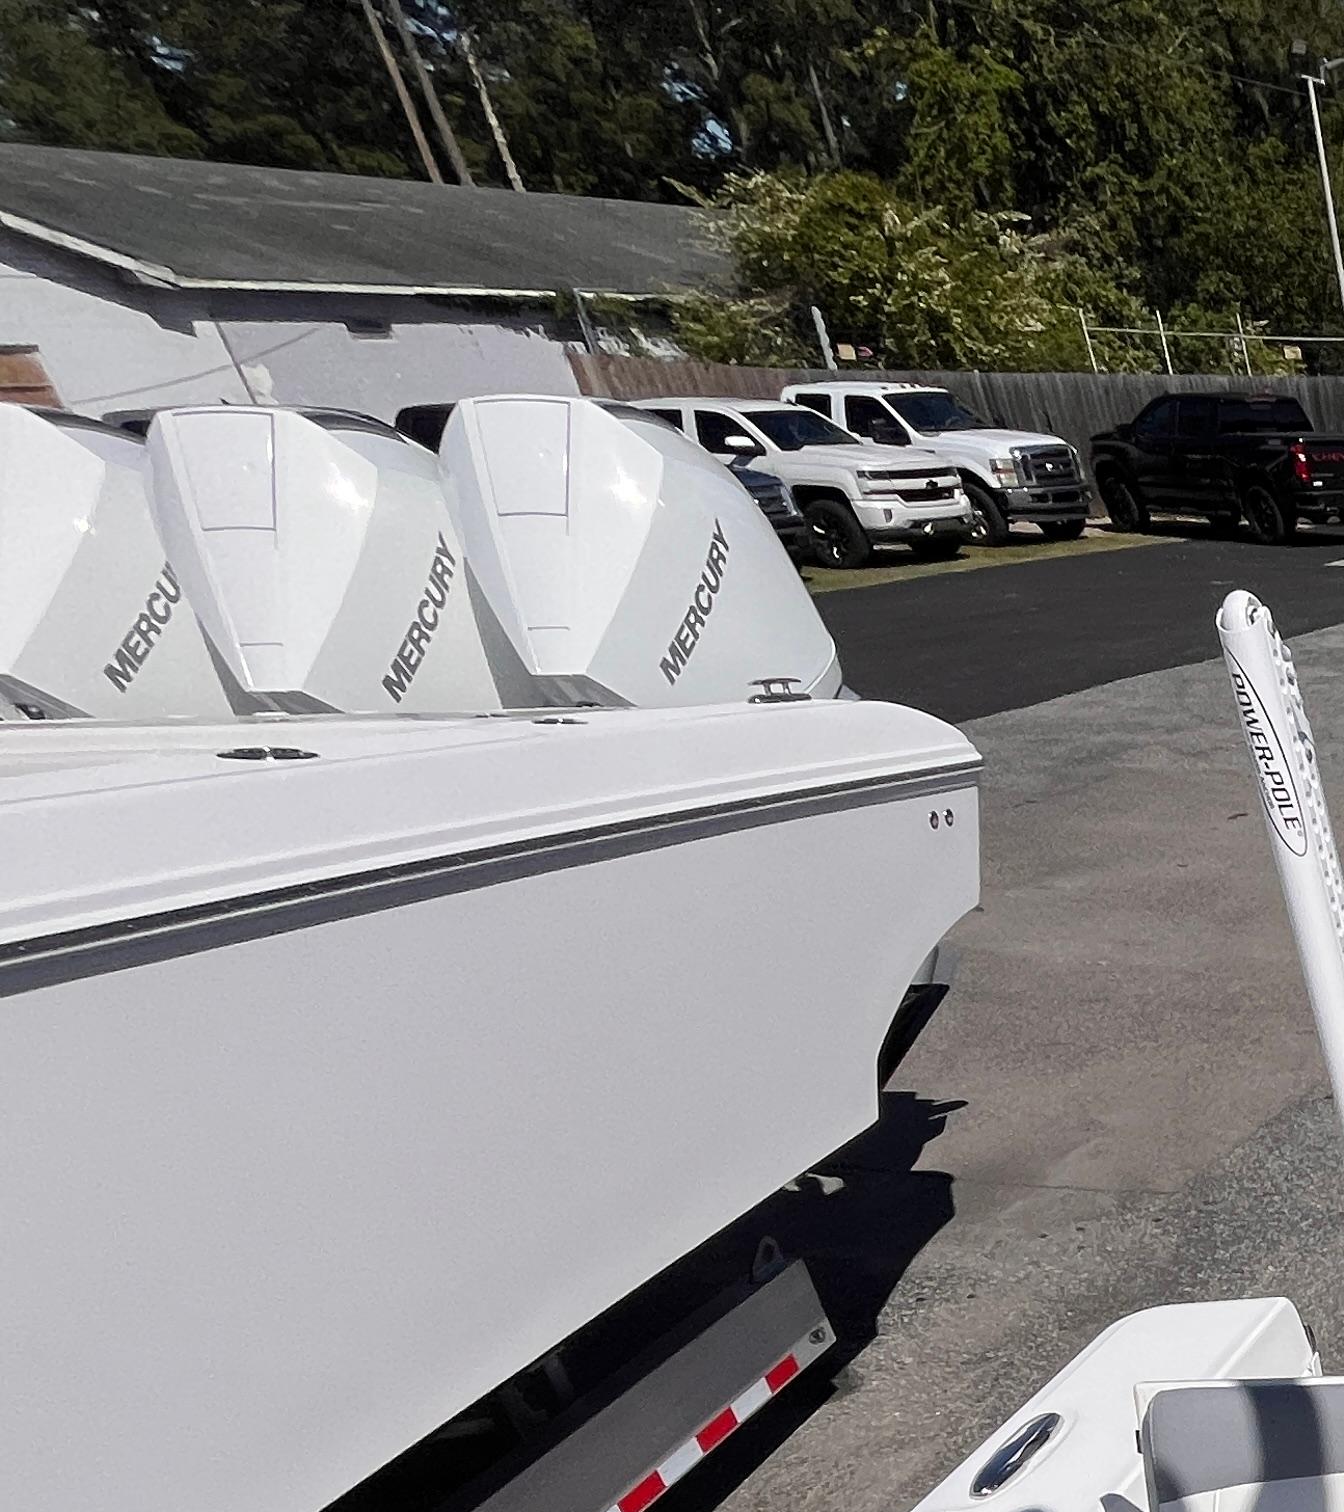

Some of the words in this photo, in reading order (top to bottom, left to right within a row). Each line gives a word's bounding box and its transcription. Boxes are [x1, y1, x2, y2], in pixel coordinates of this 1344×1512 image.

[104, 560, 181, 693] MERCU
[382, 530, 456, 703] MERCURY
[659, 517, 730, 687] MERCURY
